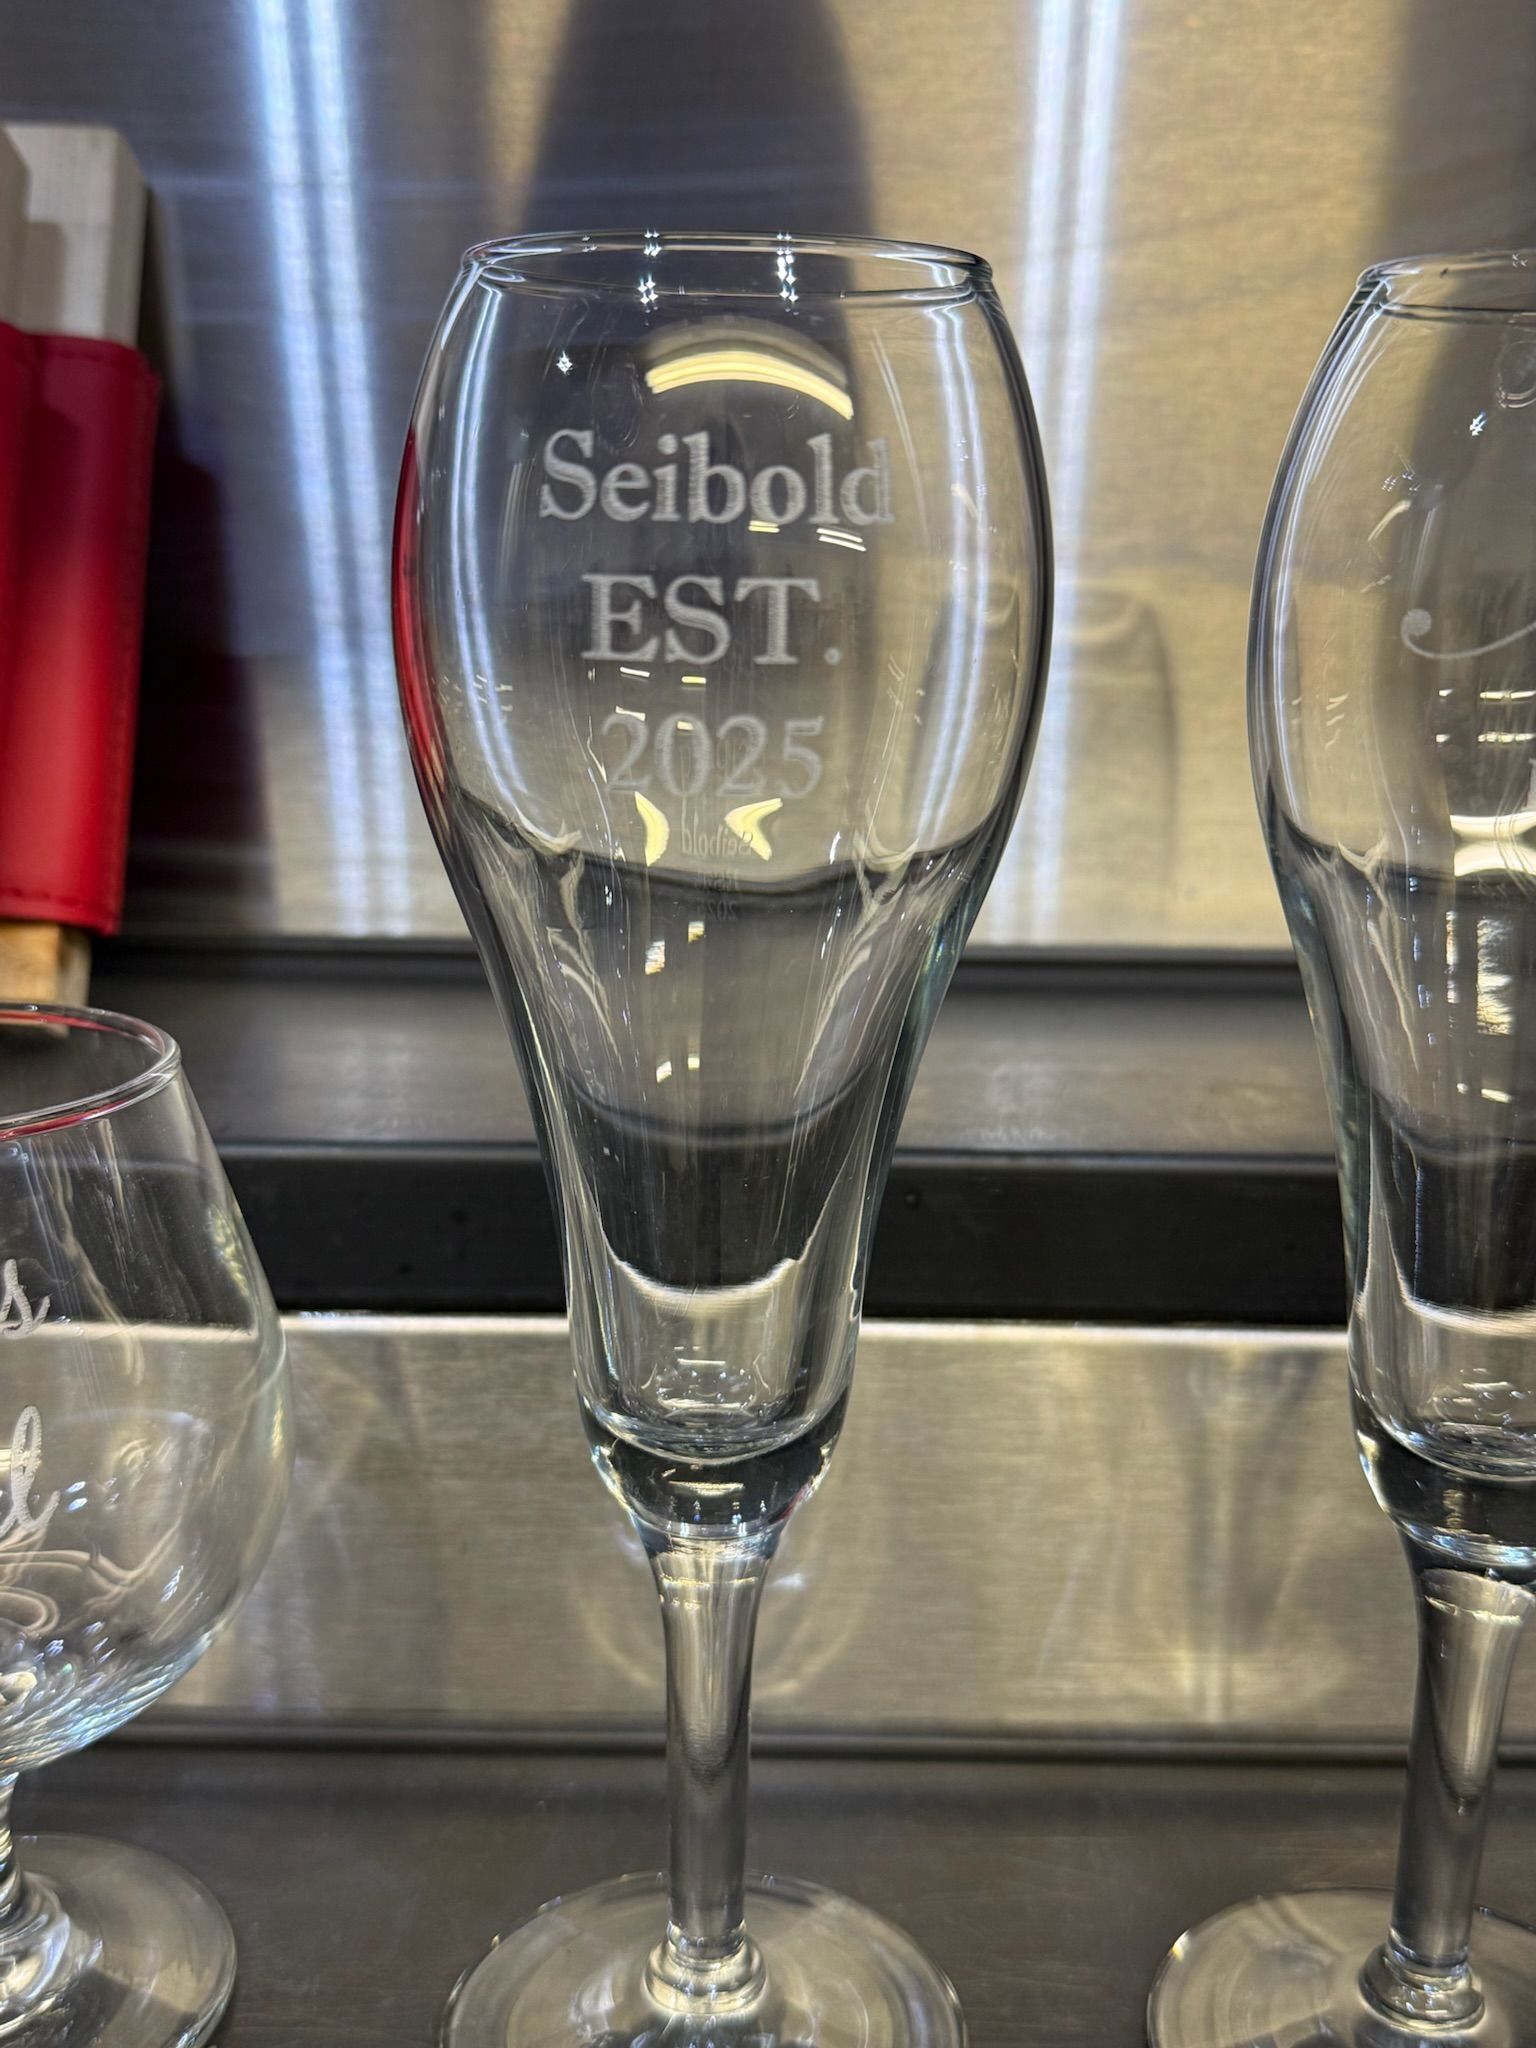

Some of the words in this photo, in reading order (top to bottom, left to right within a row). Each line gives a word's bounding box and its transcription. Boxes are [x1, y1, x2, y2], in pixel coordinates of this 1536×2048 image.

[539, 428, 895, 525] Seibold
[581, 573, 842, 665] EST.
[601, 712, 825, 798] 2025
